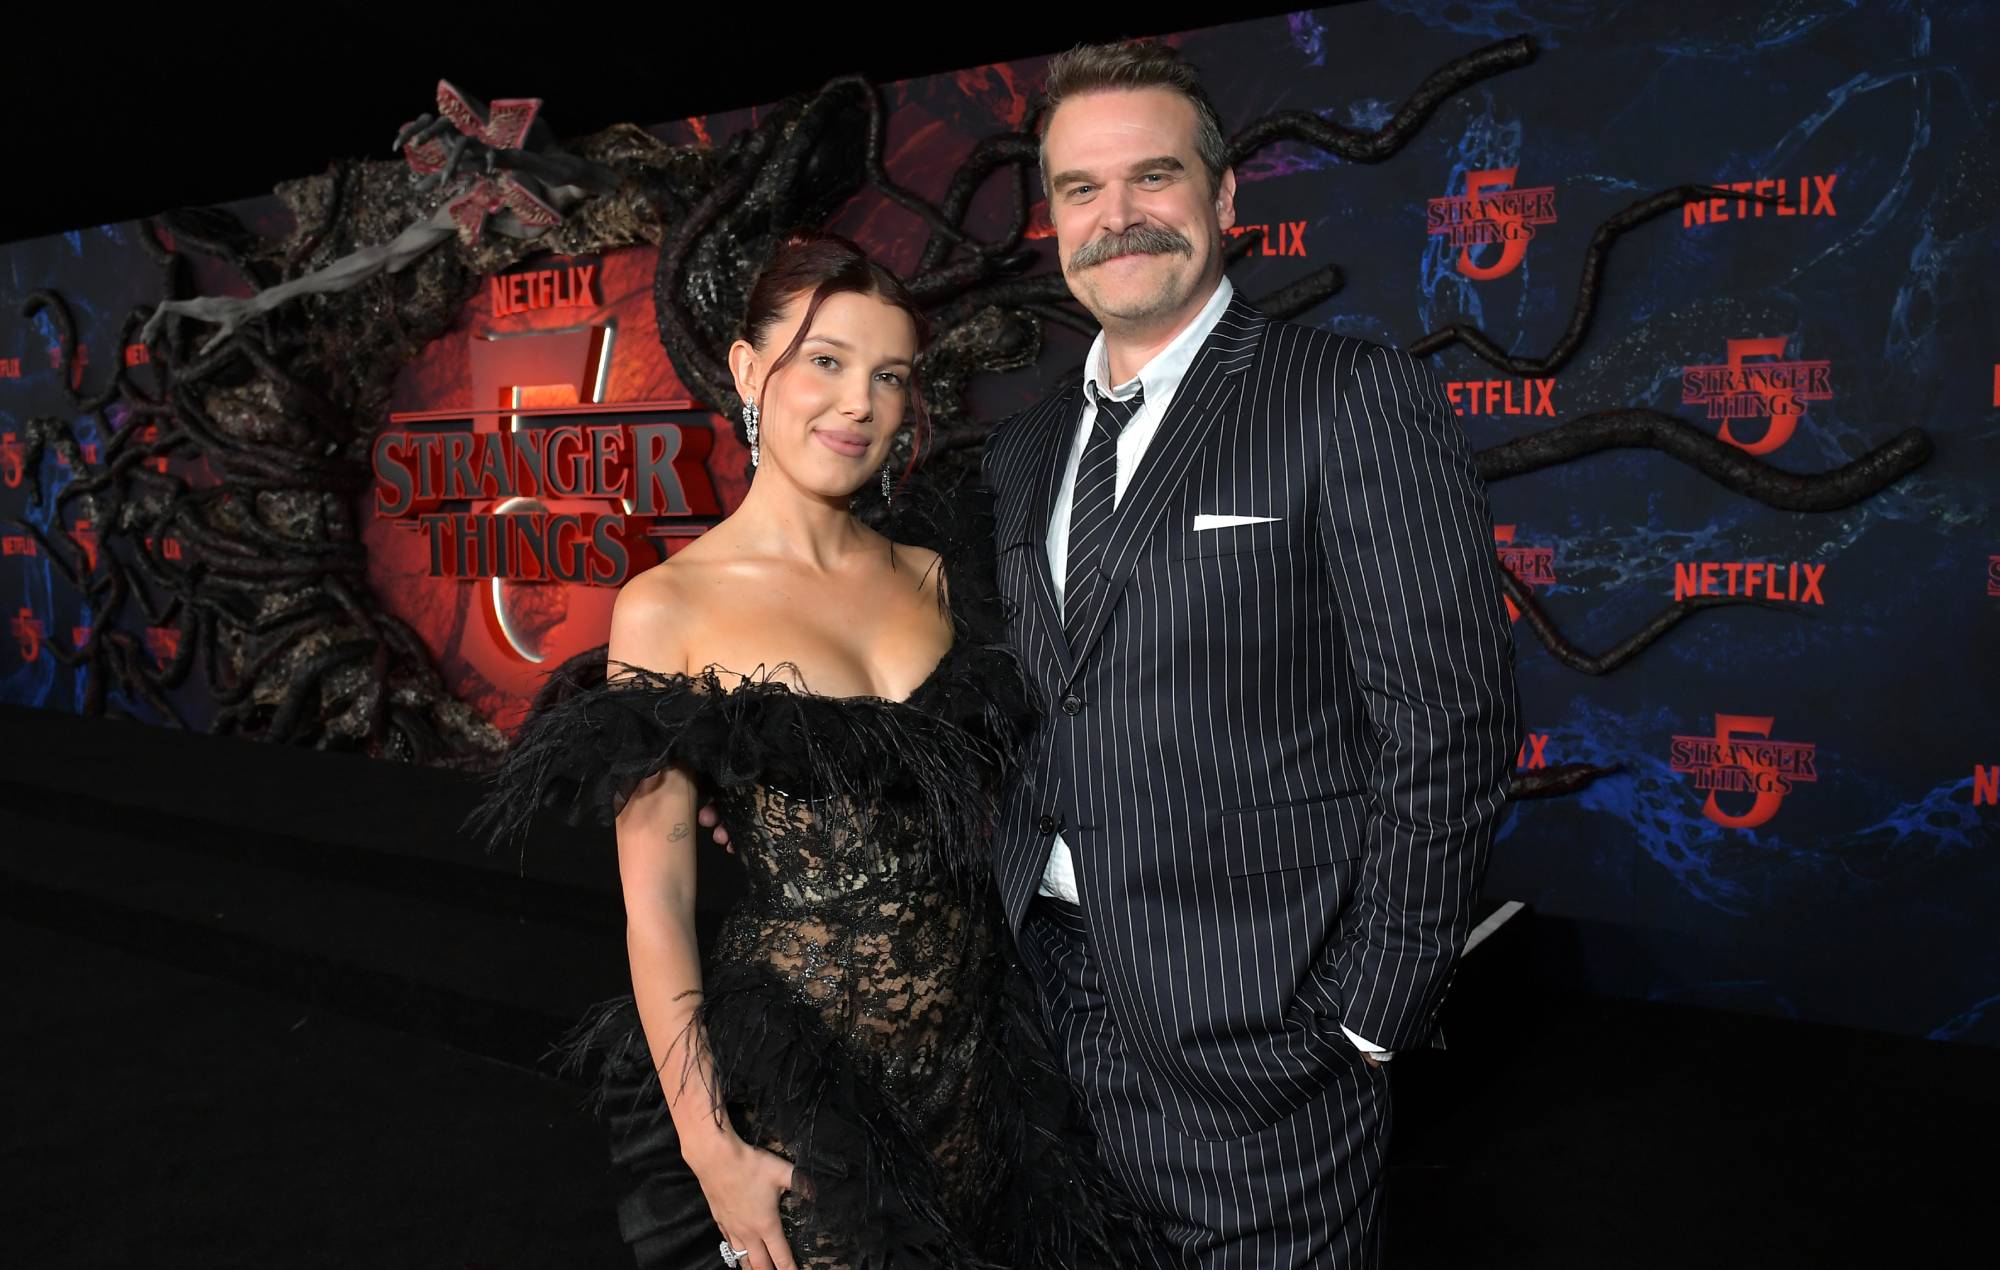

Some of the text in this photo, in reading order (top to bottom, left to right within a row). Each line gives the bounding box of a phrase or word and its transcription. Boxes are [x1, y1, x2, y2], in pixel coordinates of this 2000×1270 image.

[1427, 191, 1557, 228] STRANGER
[1683, 174, 1837, 228] NETFLIX
[1448, 219, 1536, 247] THINGS
[1457, 167, 1532, 281] 5
[491, 265, 597, 318] NETFLIX
[1442, 378, 1556, 417] ETFLIX
[1682, 366, 1834, 400] STRANGER
[1717, 336, 1799, 456] 5
[1706, 391, 1809, 419] THINGS
[372, 423, 694, 519] STRANGER
[420, 512, 631, 588] THINGS
[1675, 562, 1825, 605] NETFLIX
[1671, 740, 1817, 777] STRANGER
[1702, 712, 1784, 829] 5
[1694, 766, 1793, 795] THINGS
